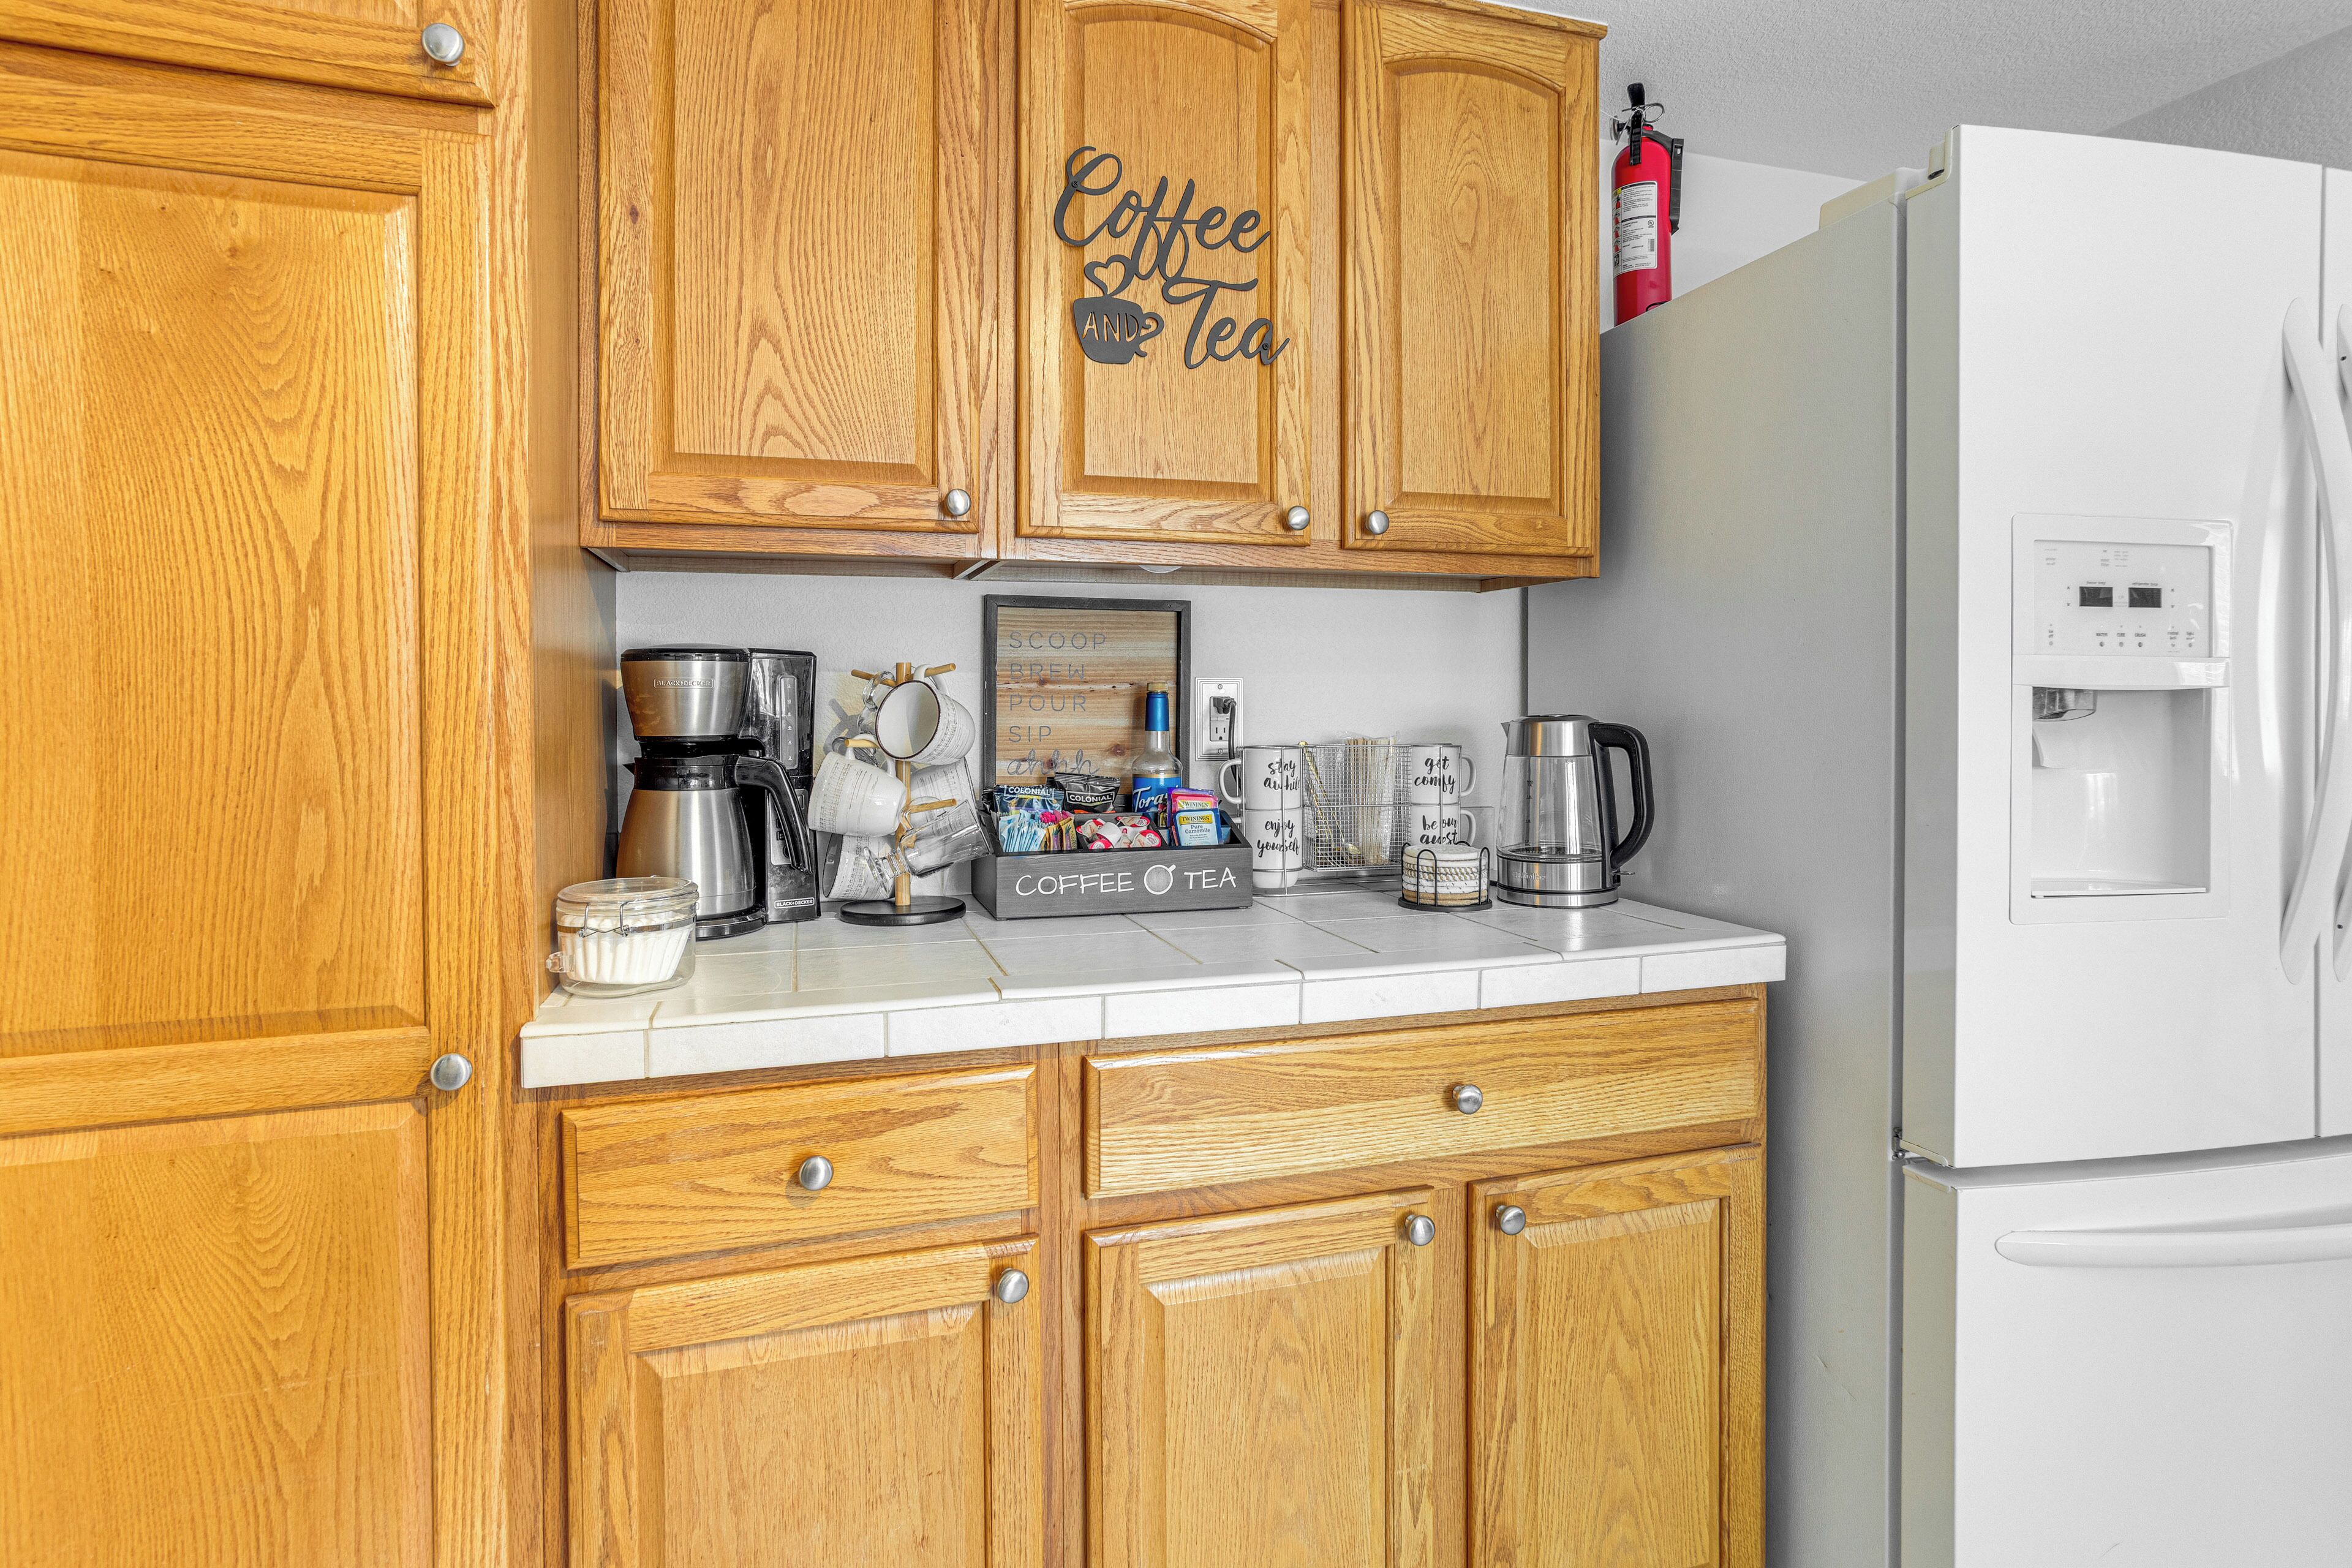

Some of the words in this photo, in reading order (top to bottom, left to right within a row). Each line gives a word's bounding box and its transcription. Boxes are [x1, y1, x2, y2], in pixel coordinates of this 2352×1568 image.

[1054, 146, 1271, 281] Coffee
[1082, 311, 1140, 343] AND
[1161, 277, 1290, 369] Tea
[1009, 630, 1107, 650] SCOOP
[1009, 663, 1085, 680] BREW
[1009, 693, 1087, 712] POUR
[1009, 725, 1052, 743] SIP
[1007, 748, 1099, 776] ahhh
[1267, 758, 1297, 777] stay
[1424, 756, 1450, 775] get
[1008, 786, 1051, 796] COLONIAL
[1414, 774, 1456, 794] comfy
[1069, 794, 1112, 803] COLONIAL
[1133, 785, 1169, 813] Tora
[1264, 819, 1295, 838] enjoy
[1422, 815, 1439, 831] be
[1442, 818, 1458, 829] our
[1256, 837, 1300, 858] yourself
[1014, 872, 1134, 897] COFFEE
[1184, 867, 1237, 890] TEA
[775, 899, 813, 908] BLACK+DECKER
